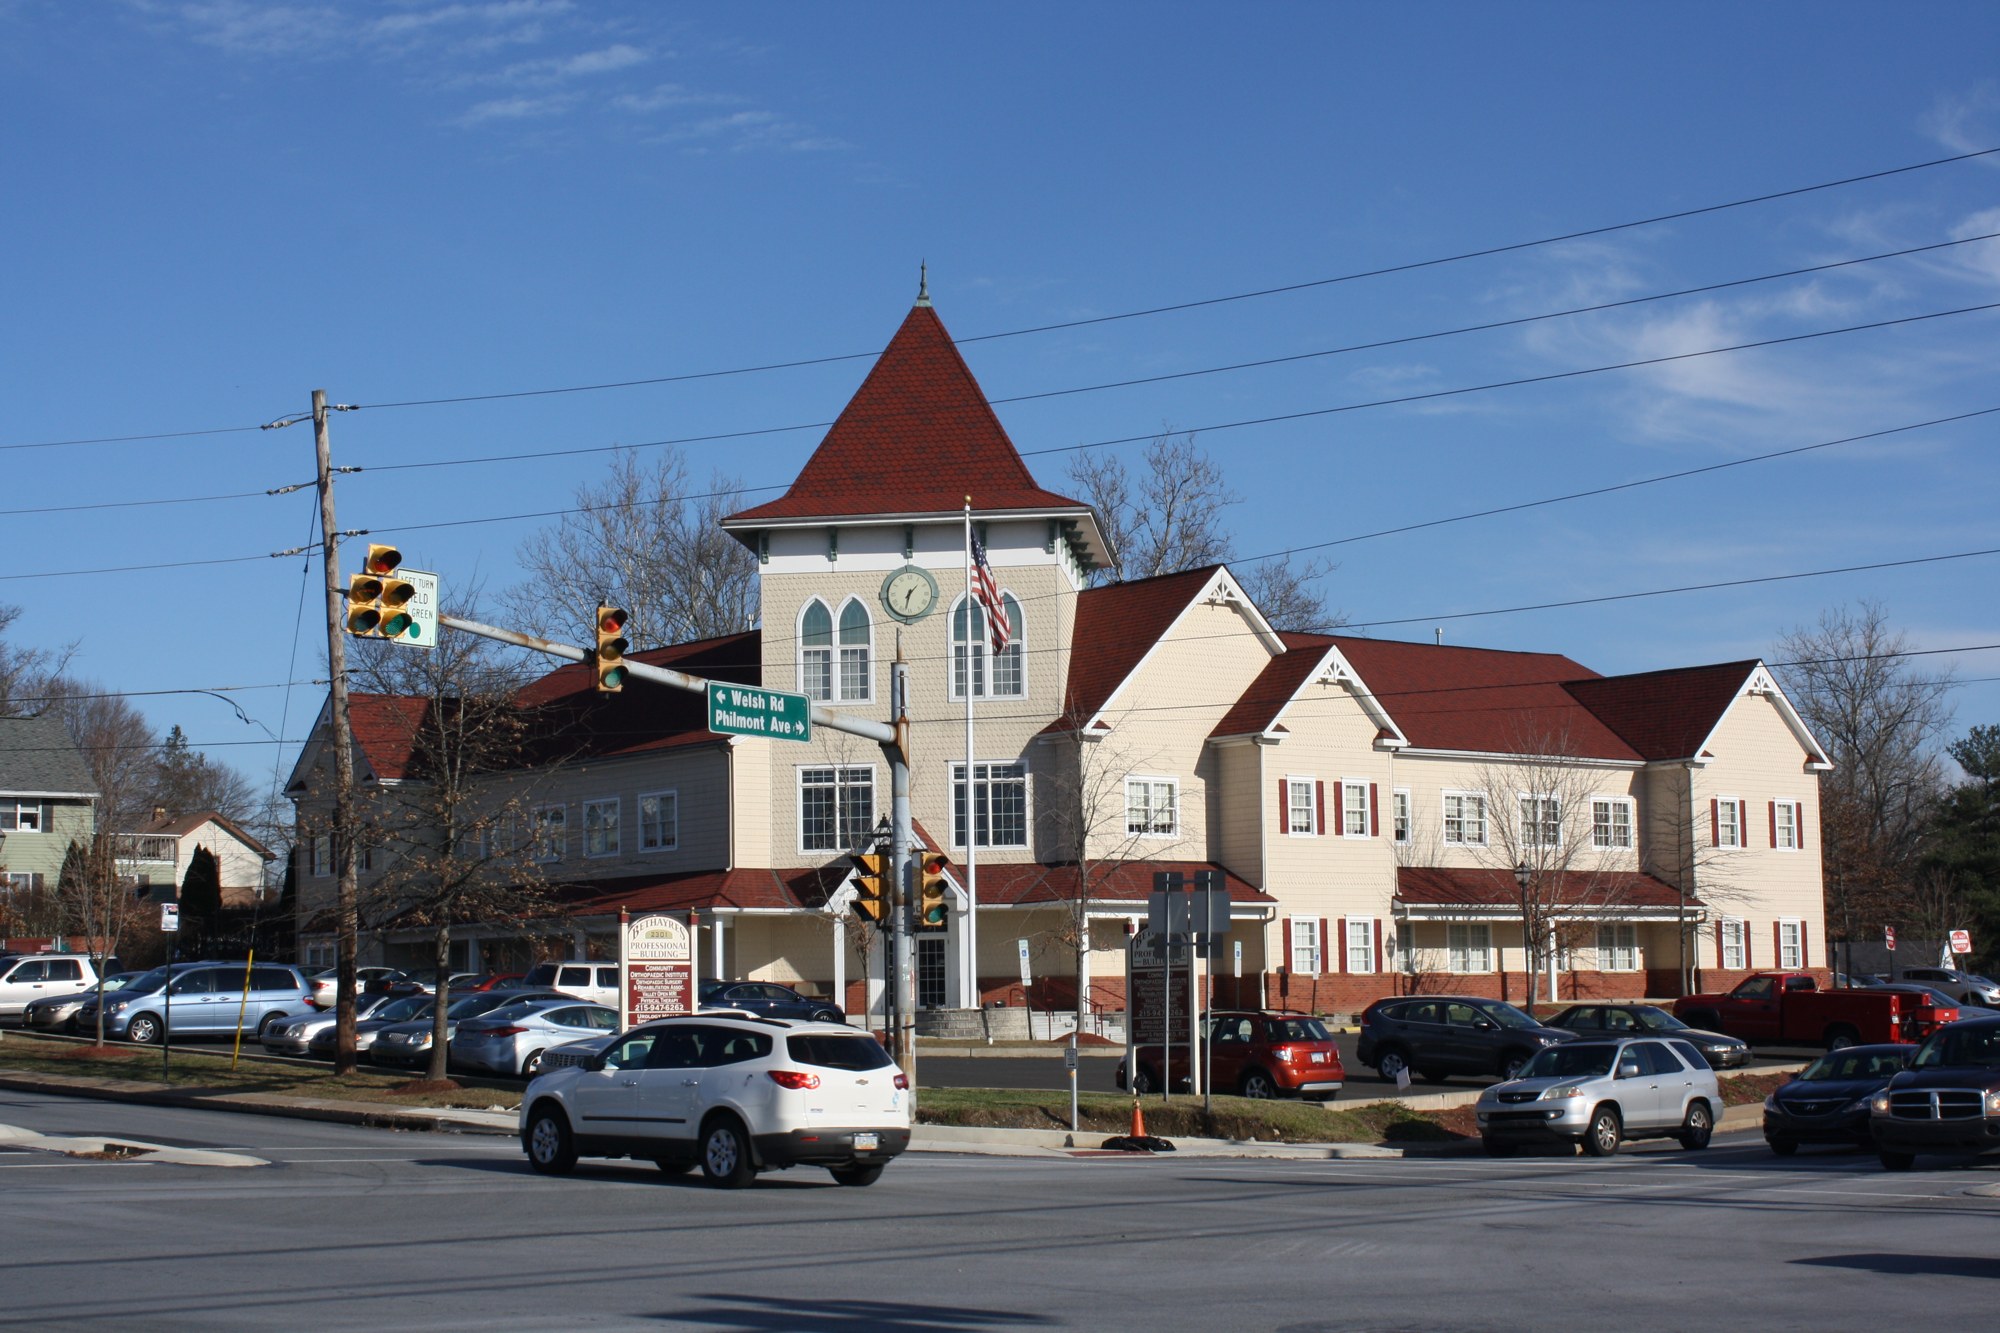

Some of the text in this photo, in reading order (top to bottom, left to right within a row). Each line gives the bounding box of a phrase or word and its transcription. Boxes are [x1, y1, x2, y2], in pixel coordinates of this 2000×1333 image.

[418, 579, 434, 590] TURN
[412, 608, 433, 619] GREEN
[731, 690, 785, 712] Welsh Rd
[715, 709, 791, 734] Philmont Ave
[632, 918, 686, 940] BETHAYRES
